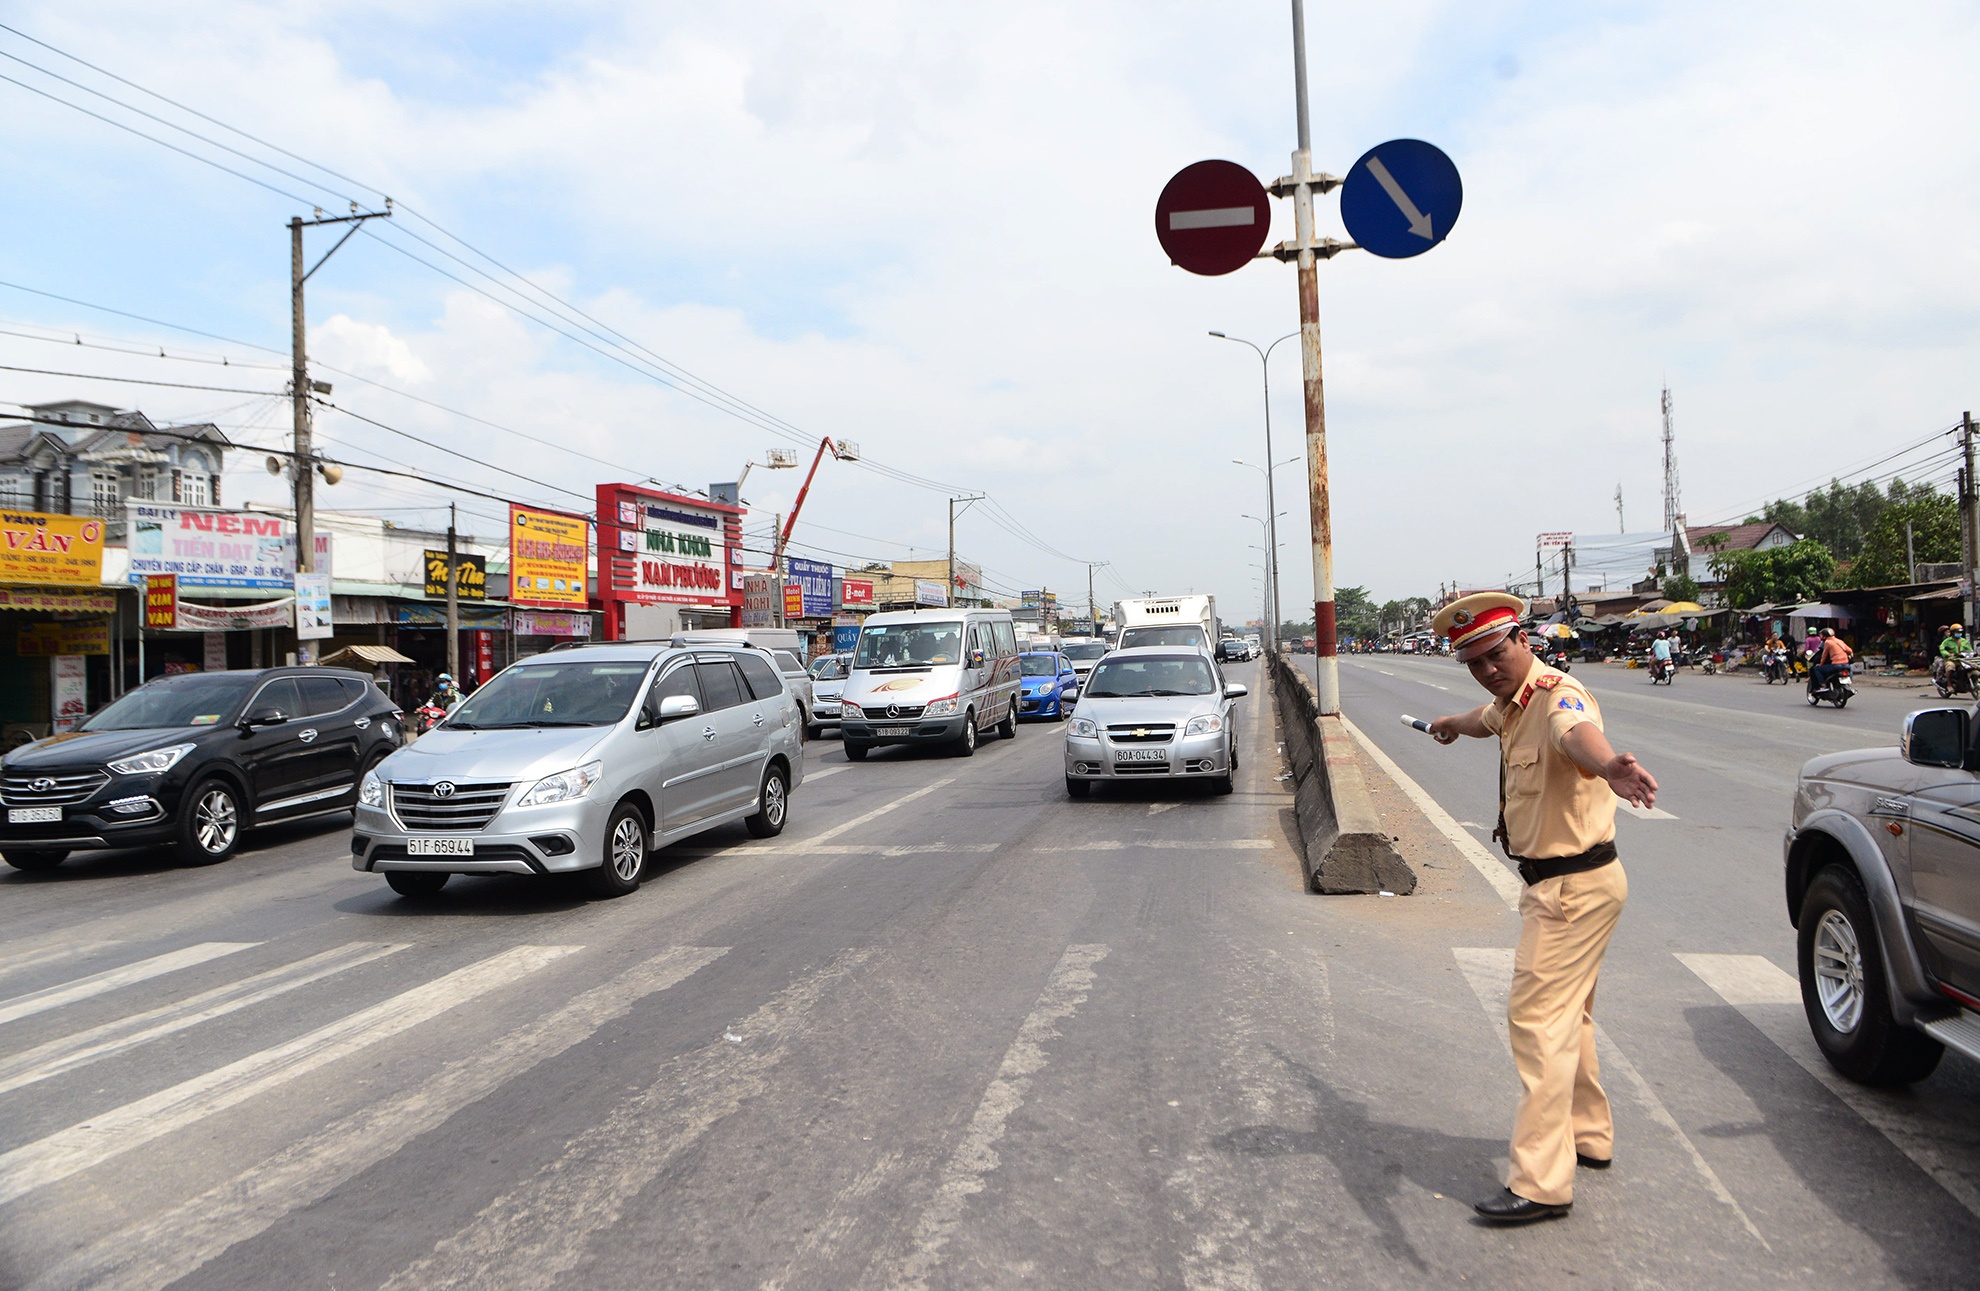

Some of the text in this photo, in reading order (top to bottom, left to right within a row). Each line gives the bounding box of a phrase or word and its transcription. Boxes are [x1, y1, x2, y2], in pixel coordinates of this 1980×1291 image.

[678, 533, 712, 558] KHOA
[642, 560, 672, 587] NAM
[746, 577, 768, 594] NHÀ
[785, 588, 800, 596] Motel
[409, 840, 471, 853] 51F-659.44
